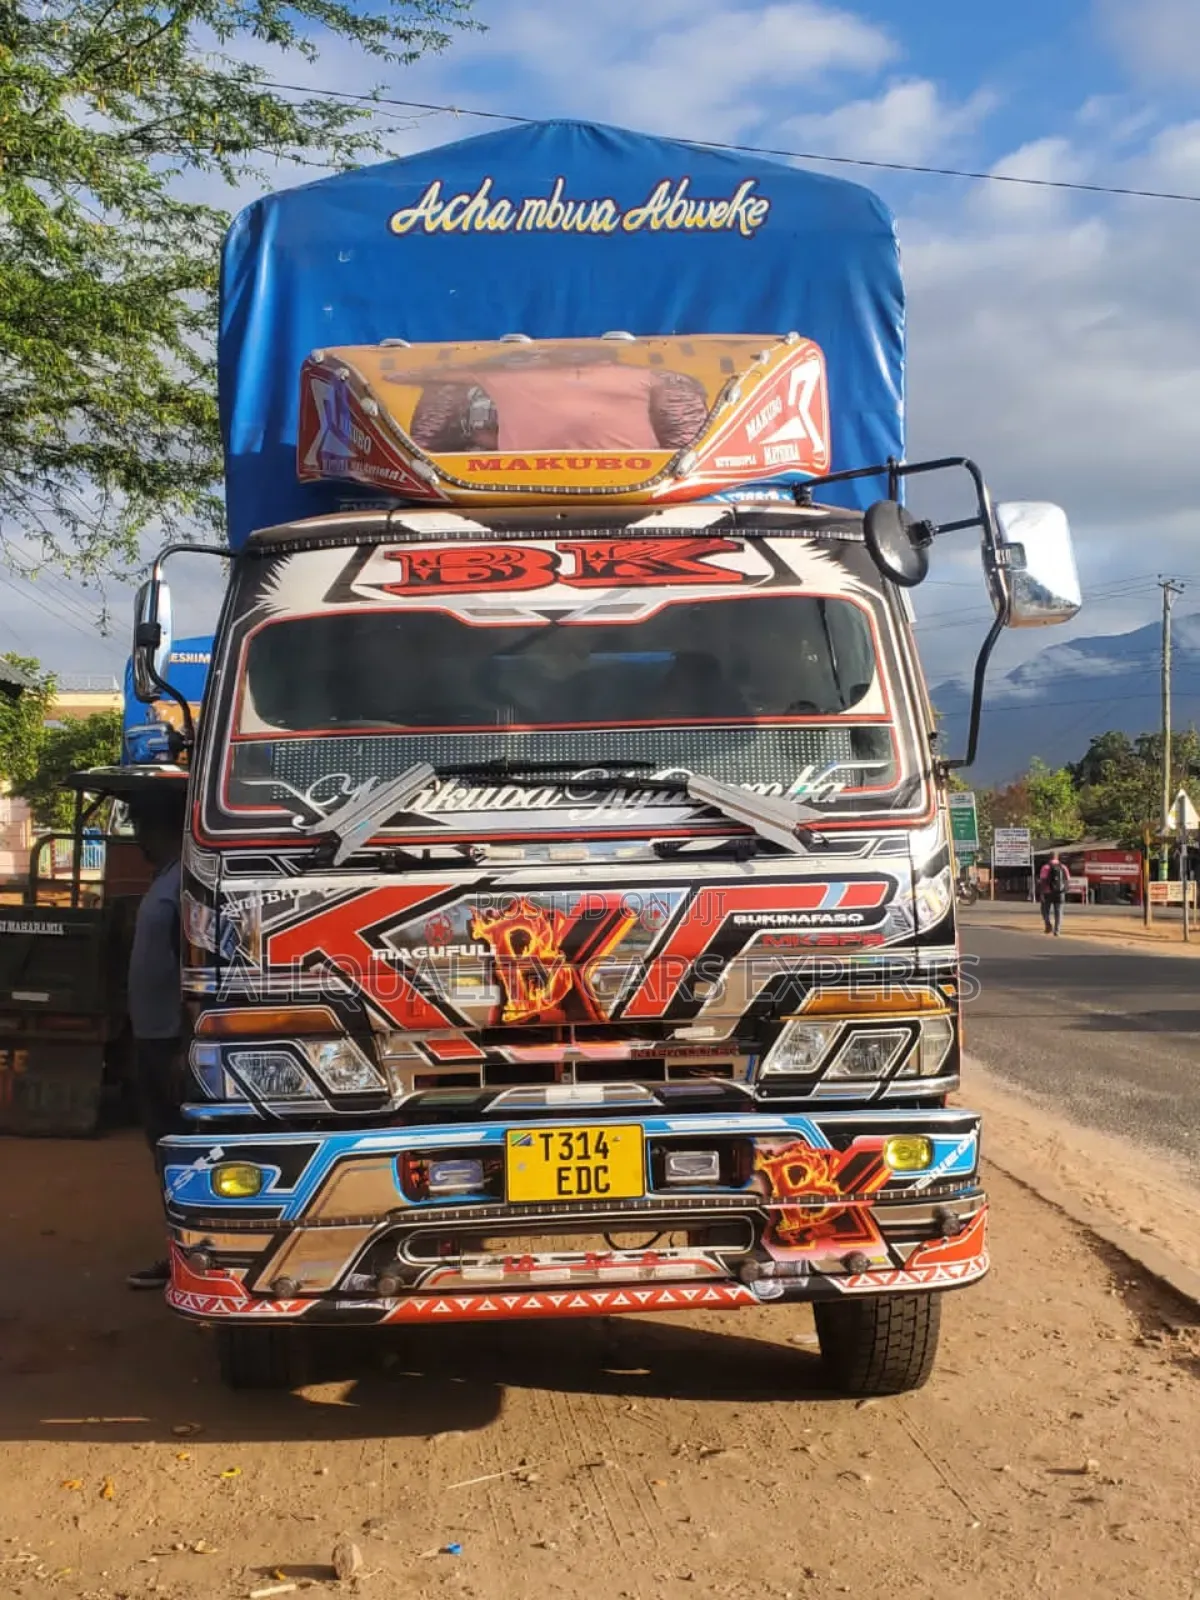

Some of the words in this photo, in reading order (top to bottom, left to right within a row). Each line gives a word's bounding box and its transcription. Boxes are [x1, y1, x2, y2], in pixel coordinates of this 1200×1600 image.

[389, 177, 517, 234] Acha
[517, 176, 621, 232] mbwa
[621, 177, 769, 238] Abweke
[467, 457, 652, 471] MAKUBO
[382, 537, 745, 597] BK
[733, 913, 864, 925] BUKINAFASO
[372, 944, 496, 960] MAGUFULI
[539, 1131, 610, 1161] T314
[557, 1165, 610, 1195] EDC
